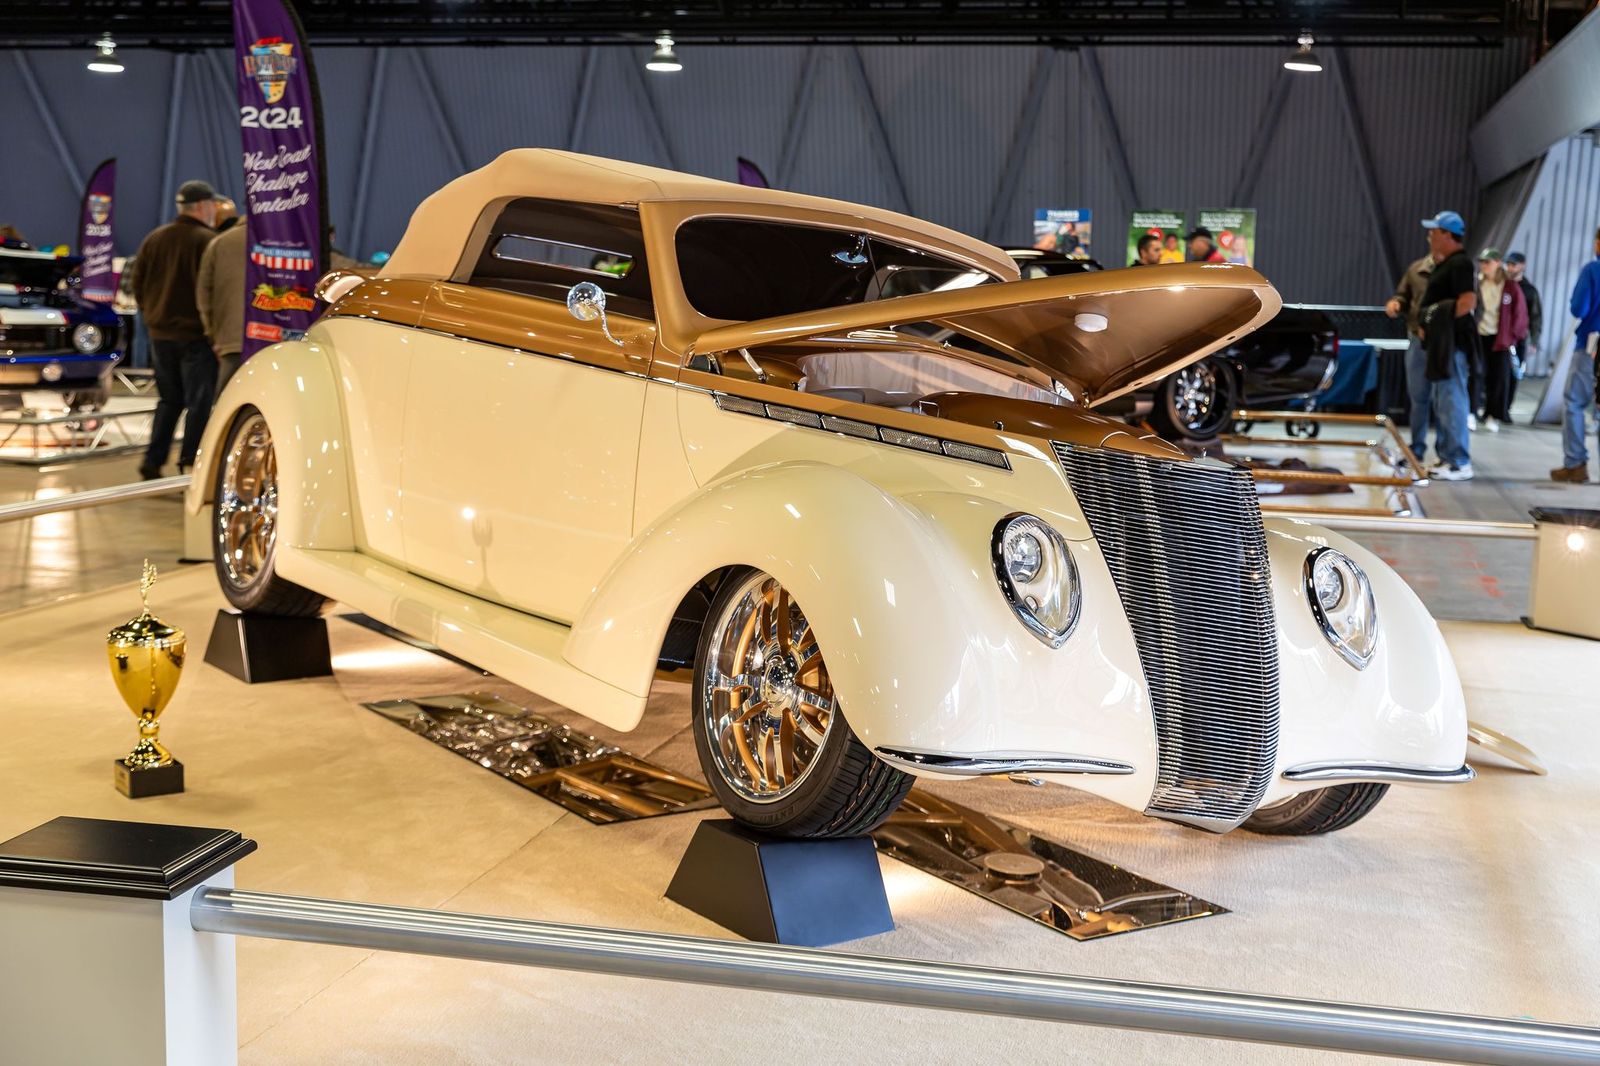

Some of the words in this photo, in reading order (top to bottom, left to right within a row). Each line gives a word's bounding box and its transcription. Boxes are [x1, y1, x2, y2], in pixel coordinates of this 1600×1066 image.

[240, 105, 303, 129] 2024
[243, 151, 279, 171] West
[278, 144, 312, 168] Coast
